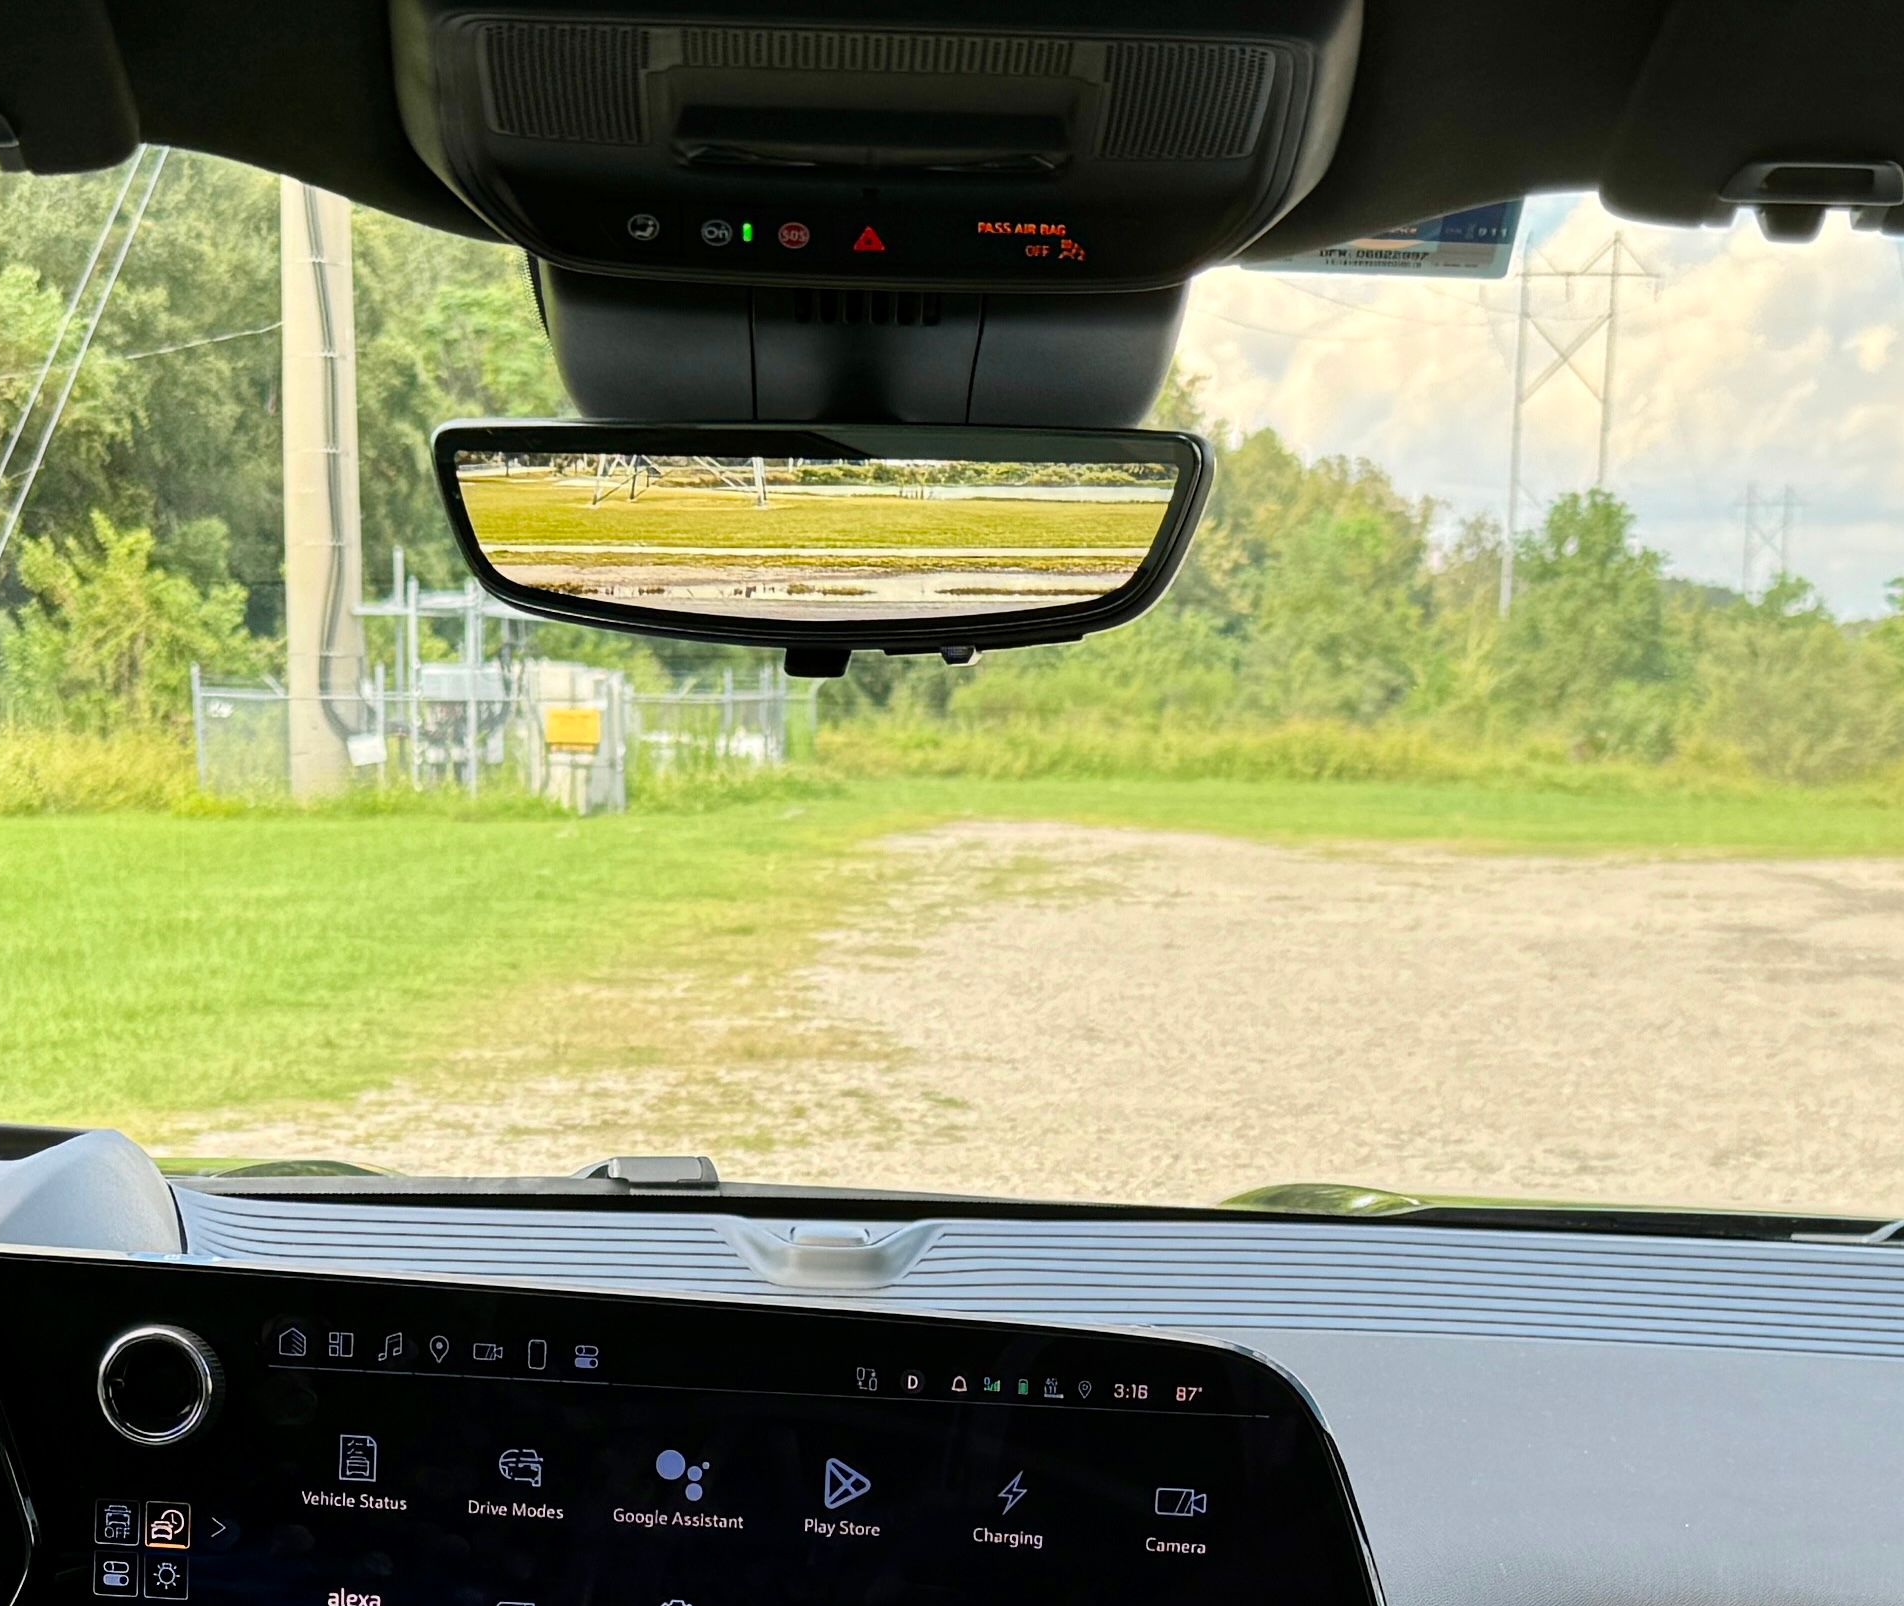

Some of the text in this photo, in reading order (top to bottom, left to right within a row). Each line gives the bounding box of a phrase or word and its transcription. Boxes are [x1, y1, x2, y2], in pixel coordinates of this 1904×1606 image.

[781, 230, 808, 242] SOS
[977, 221, 1067, 237] PASS AIR BAG
[1024, 244, 1050, 257] OFF
[1113, 1383, 1148, 1400] 3:16
[301, 1490, 407, 1511] Vehicle Status
[468, 1499, 564, 1520] Drive Modes
[613, 1507, 744, 1529] Google Assistant
[105, 1526, 129, 1539] OFF
[804, 1518, 881, 1538] Play Store
[972, 1527, 1043, 1550] Charging
[1145, 1536, 1206, 1555] Camera
